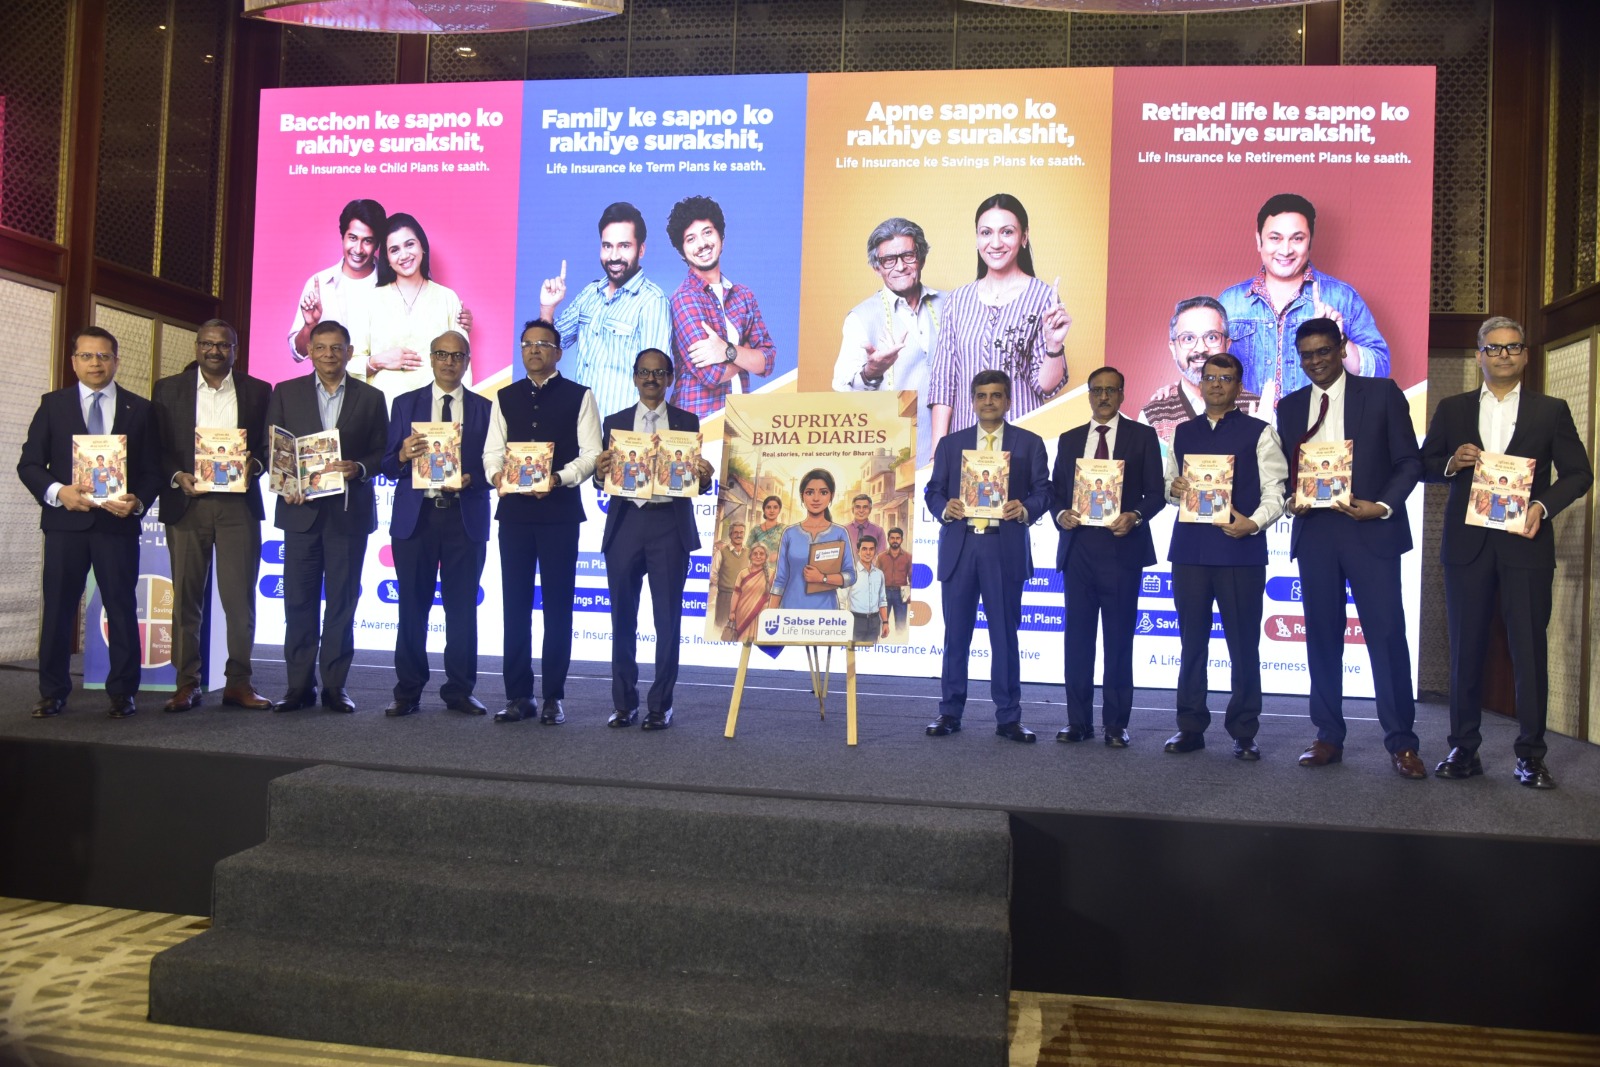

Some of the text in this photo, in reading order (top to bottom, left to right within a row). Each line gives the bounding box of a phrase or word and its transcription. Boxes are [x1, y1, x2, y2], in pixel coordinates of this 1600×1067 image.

[542, 104, 774, 131] Family ke sapno ko
[865, 98, 1057, 125] Apne sapno ko
[1141, 101, 1410, 124] Retired life ke sapno ko
[280, 108, 503, 131] Bacchon ke sapno ko
[847, 122, 1075, 149] rakhiye surakshit,
[1173, 122, 1376, 145] rakhiye surakshit,
[296, 131, 485, 157] rakhiye surakshit,
[550, 128, 763, 155] rakhiye surakshit,
[836, 155, 1085, 169] Life Insurance ke Savings Plans ke saath.
[1138, 152, 1411, 164] Life Insurance ke Retirement Plans ke saath.
[289, 161, 490, 175] Life Insurance ke Child Plans ke saath.
[546, 160, 766, 174] Life Insurance ke Term Plans ke saath.
[771, 413, 868, 428] SUPRIYA'S
[752, 430, 887, 446] BIMA DIARIES
[815, 450, 841, 458] security
[574, 594, 592, 607] ings
[783, 616, 847, 627] Sabse Pehle
[1034, 613, 1062, 625] Plans
[782, 626, 847, 636] Life Insurance
[874, 644, 926, 655] Insurance
[1149, 655, 1157, 665] A
[1161, 655, 1181, 666] Life
